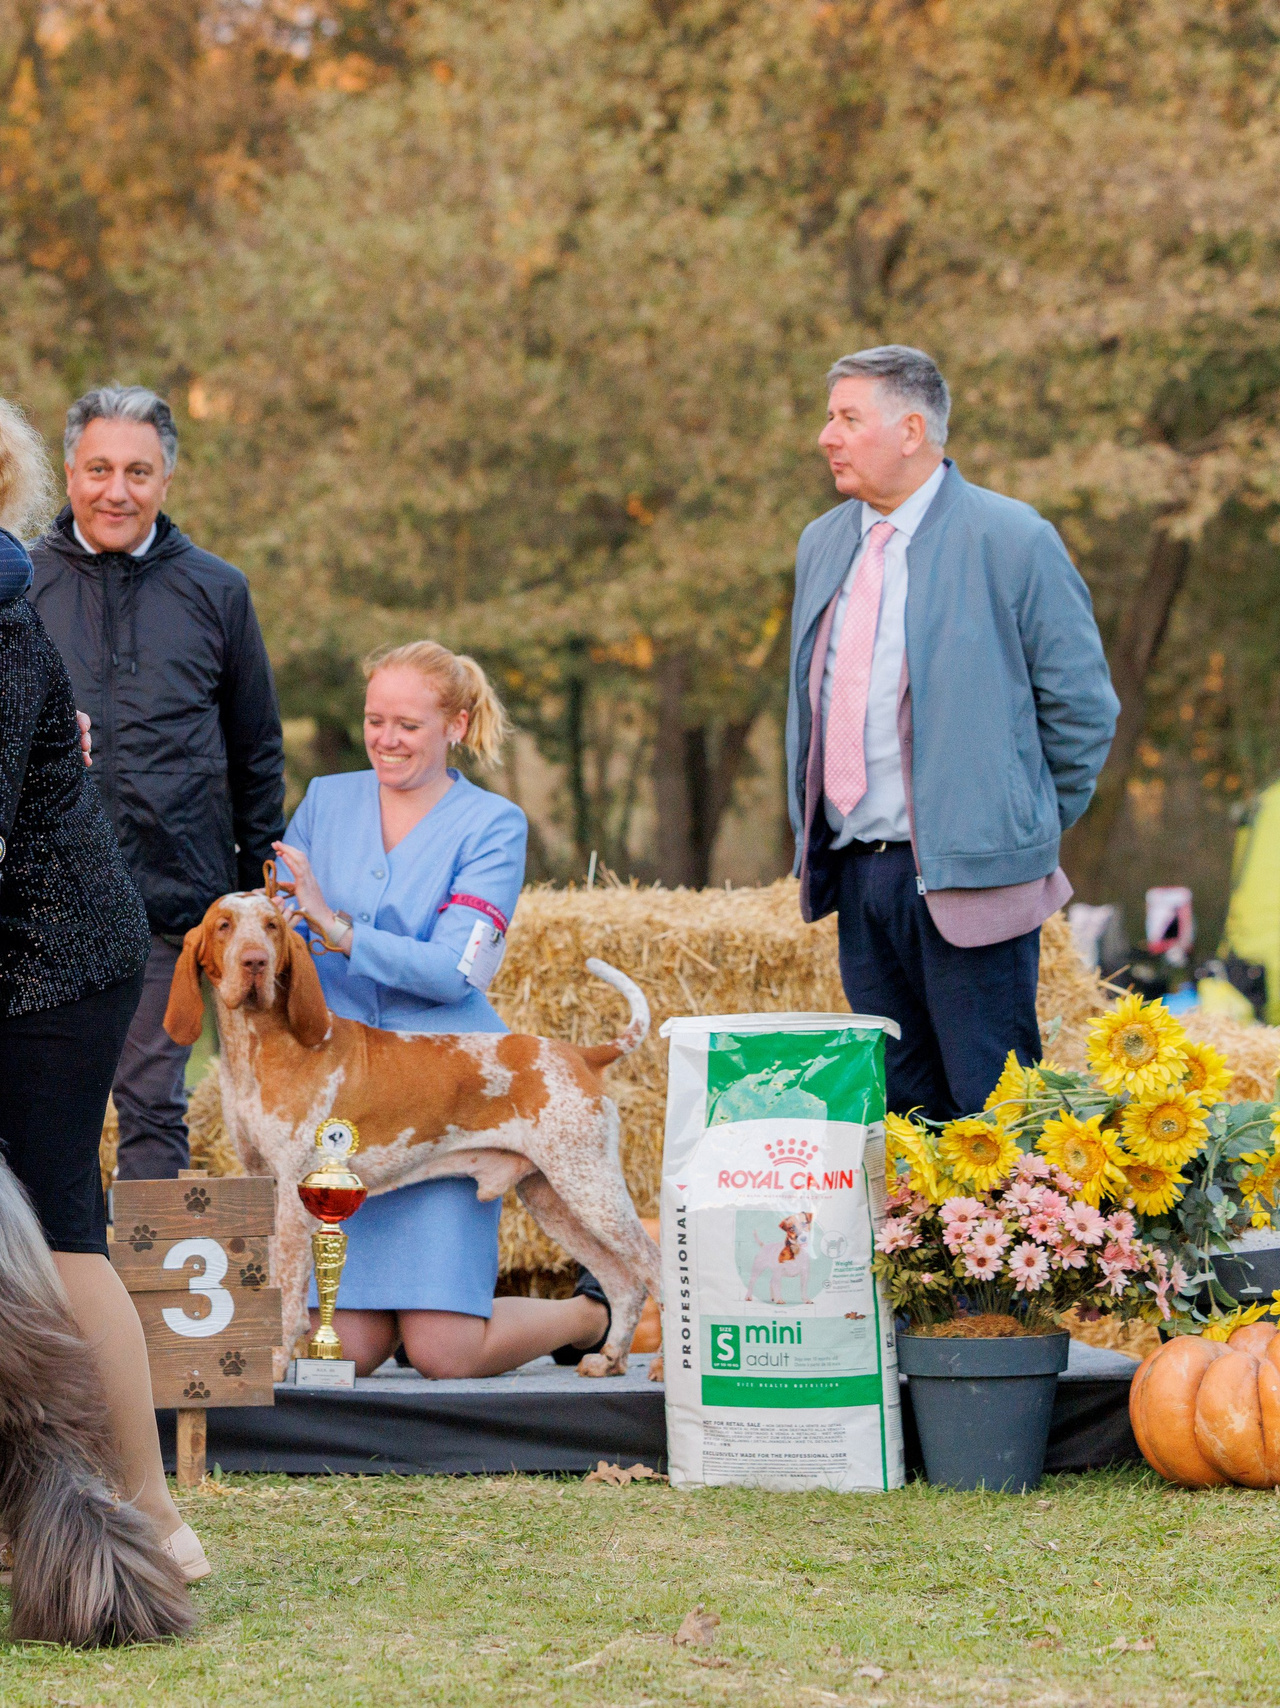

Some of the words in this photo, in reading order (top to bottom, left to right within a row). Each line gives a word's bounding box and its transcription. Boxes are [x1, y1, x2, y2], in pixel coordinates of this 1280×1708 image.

[718, 1169, 784, 1190] ROYAL
[790, 1169, 853, 1191] CANIN
[161, 1237, 235, 1338] 3
[676, 1204, 692, 1370] PROFESSIONAL
[745, 1320, 802, 1344] mini
[716, 1332, 735, 1361] S
[746, 1352, 790, 1367] adult
[702, 1450, 738, 1458] EXCLUSIVELY
